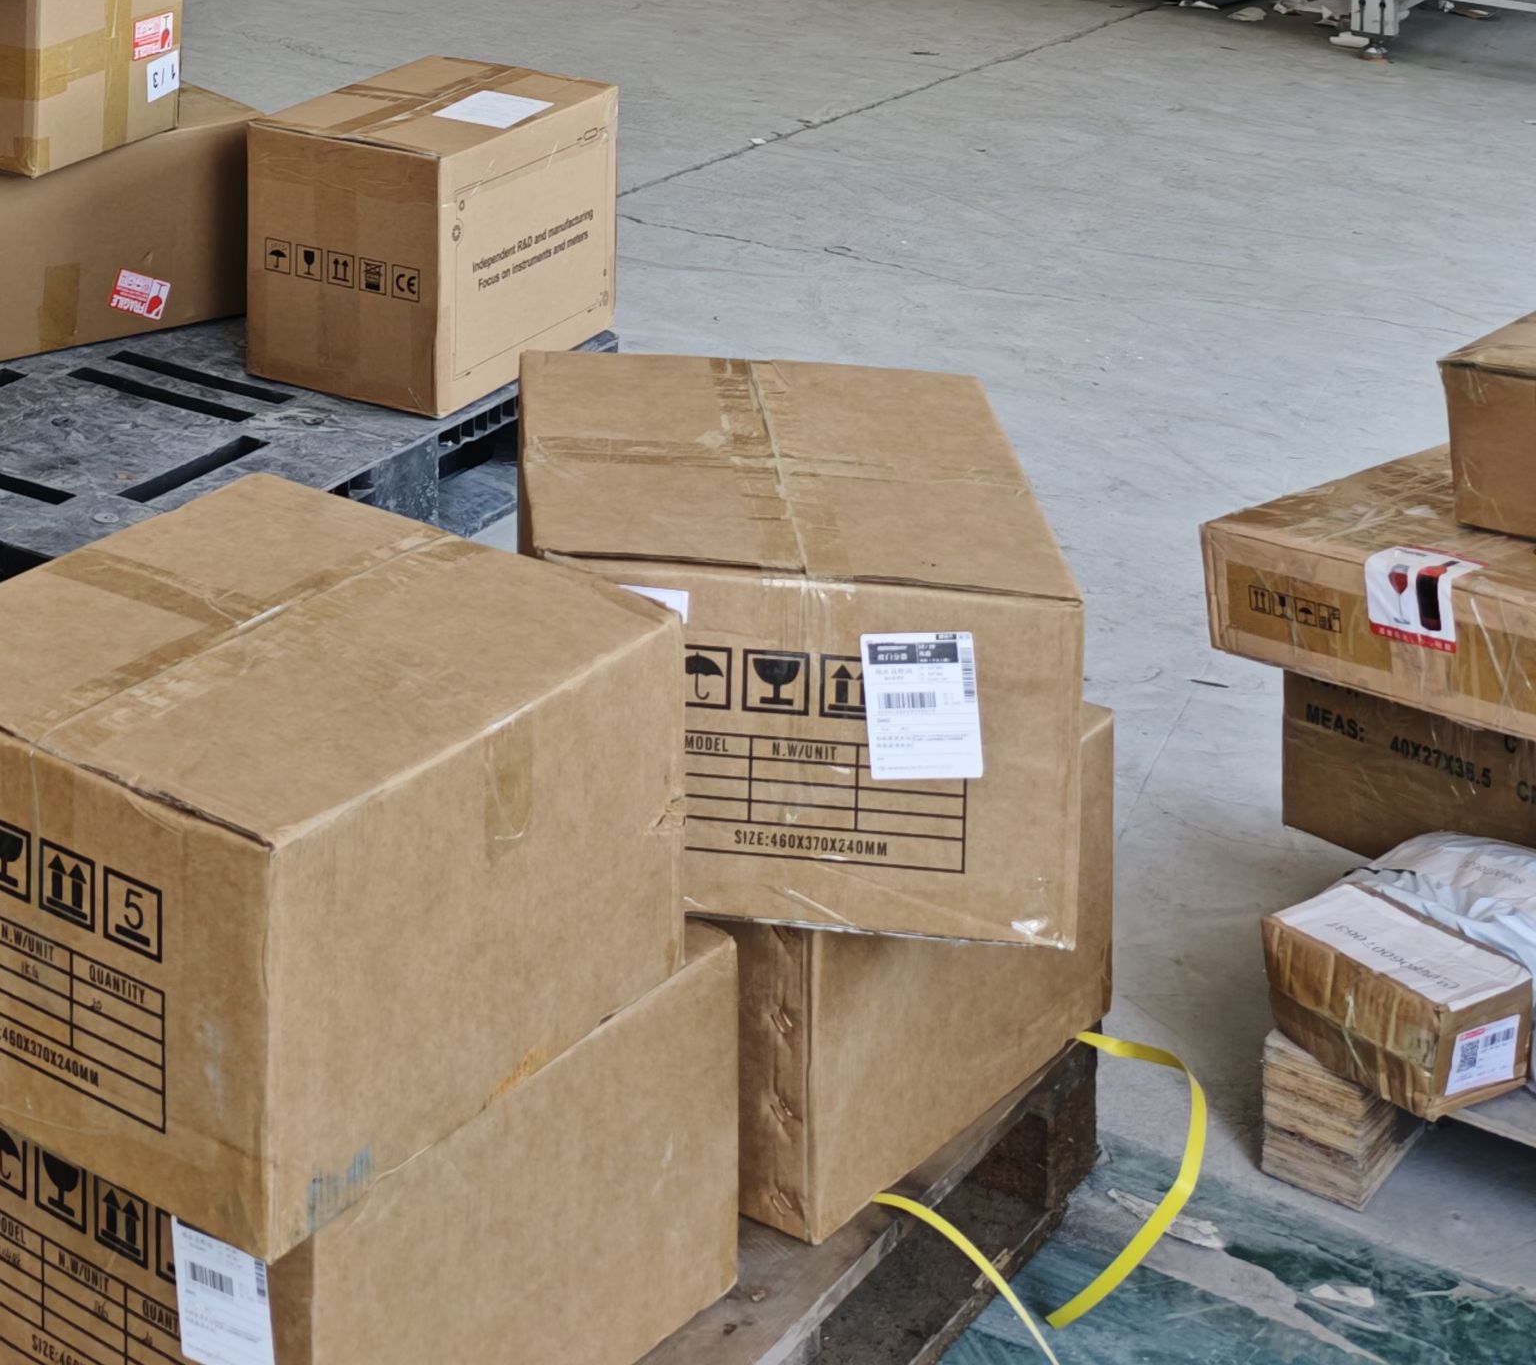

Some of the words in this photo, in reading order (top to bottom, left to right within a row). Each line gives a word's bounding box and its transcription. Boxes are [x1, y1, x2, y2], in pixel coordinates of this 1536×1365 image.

[472, 243, 516, 272] Independent
[517, 235, 533, 252] R&D
[534, 229, 547, 245] and
[548, 209, 594, 238] manufacturing
[478, 273, 500, 291] Focus
[501, 268, 511, 280] on
[512, 248, 552, 275] instruments
[553, 239, 566, 255] and
[567, 230, 589, 248] meters
[110, 294, 145, 315] FRAGILE
[1306, 703, 1365, 742] MEAS:
[685, 735, 729, 753] MODEL
[772, 742, 837, 761] N.W/UNIT
[734, 829, 888, 856] SIZE:460X370X240MM
[124, 888, 144, 930] 5
[1, 923, 56, 962] N.W/UNIT
[89, 964, 146, 1004] QUANTITY
[58, 1251, 110, 1294] N.W/UNIT
